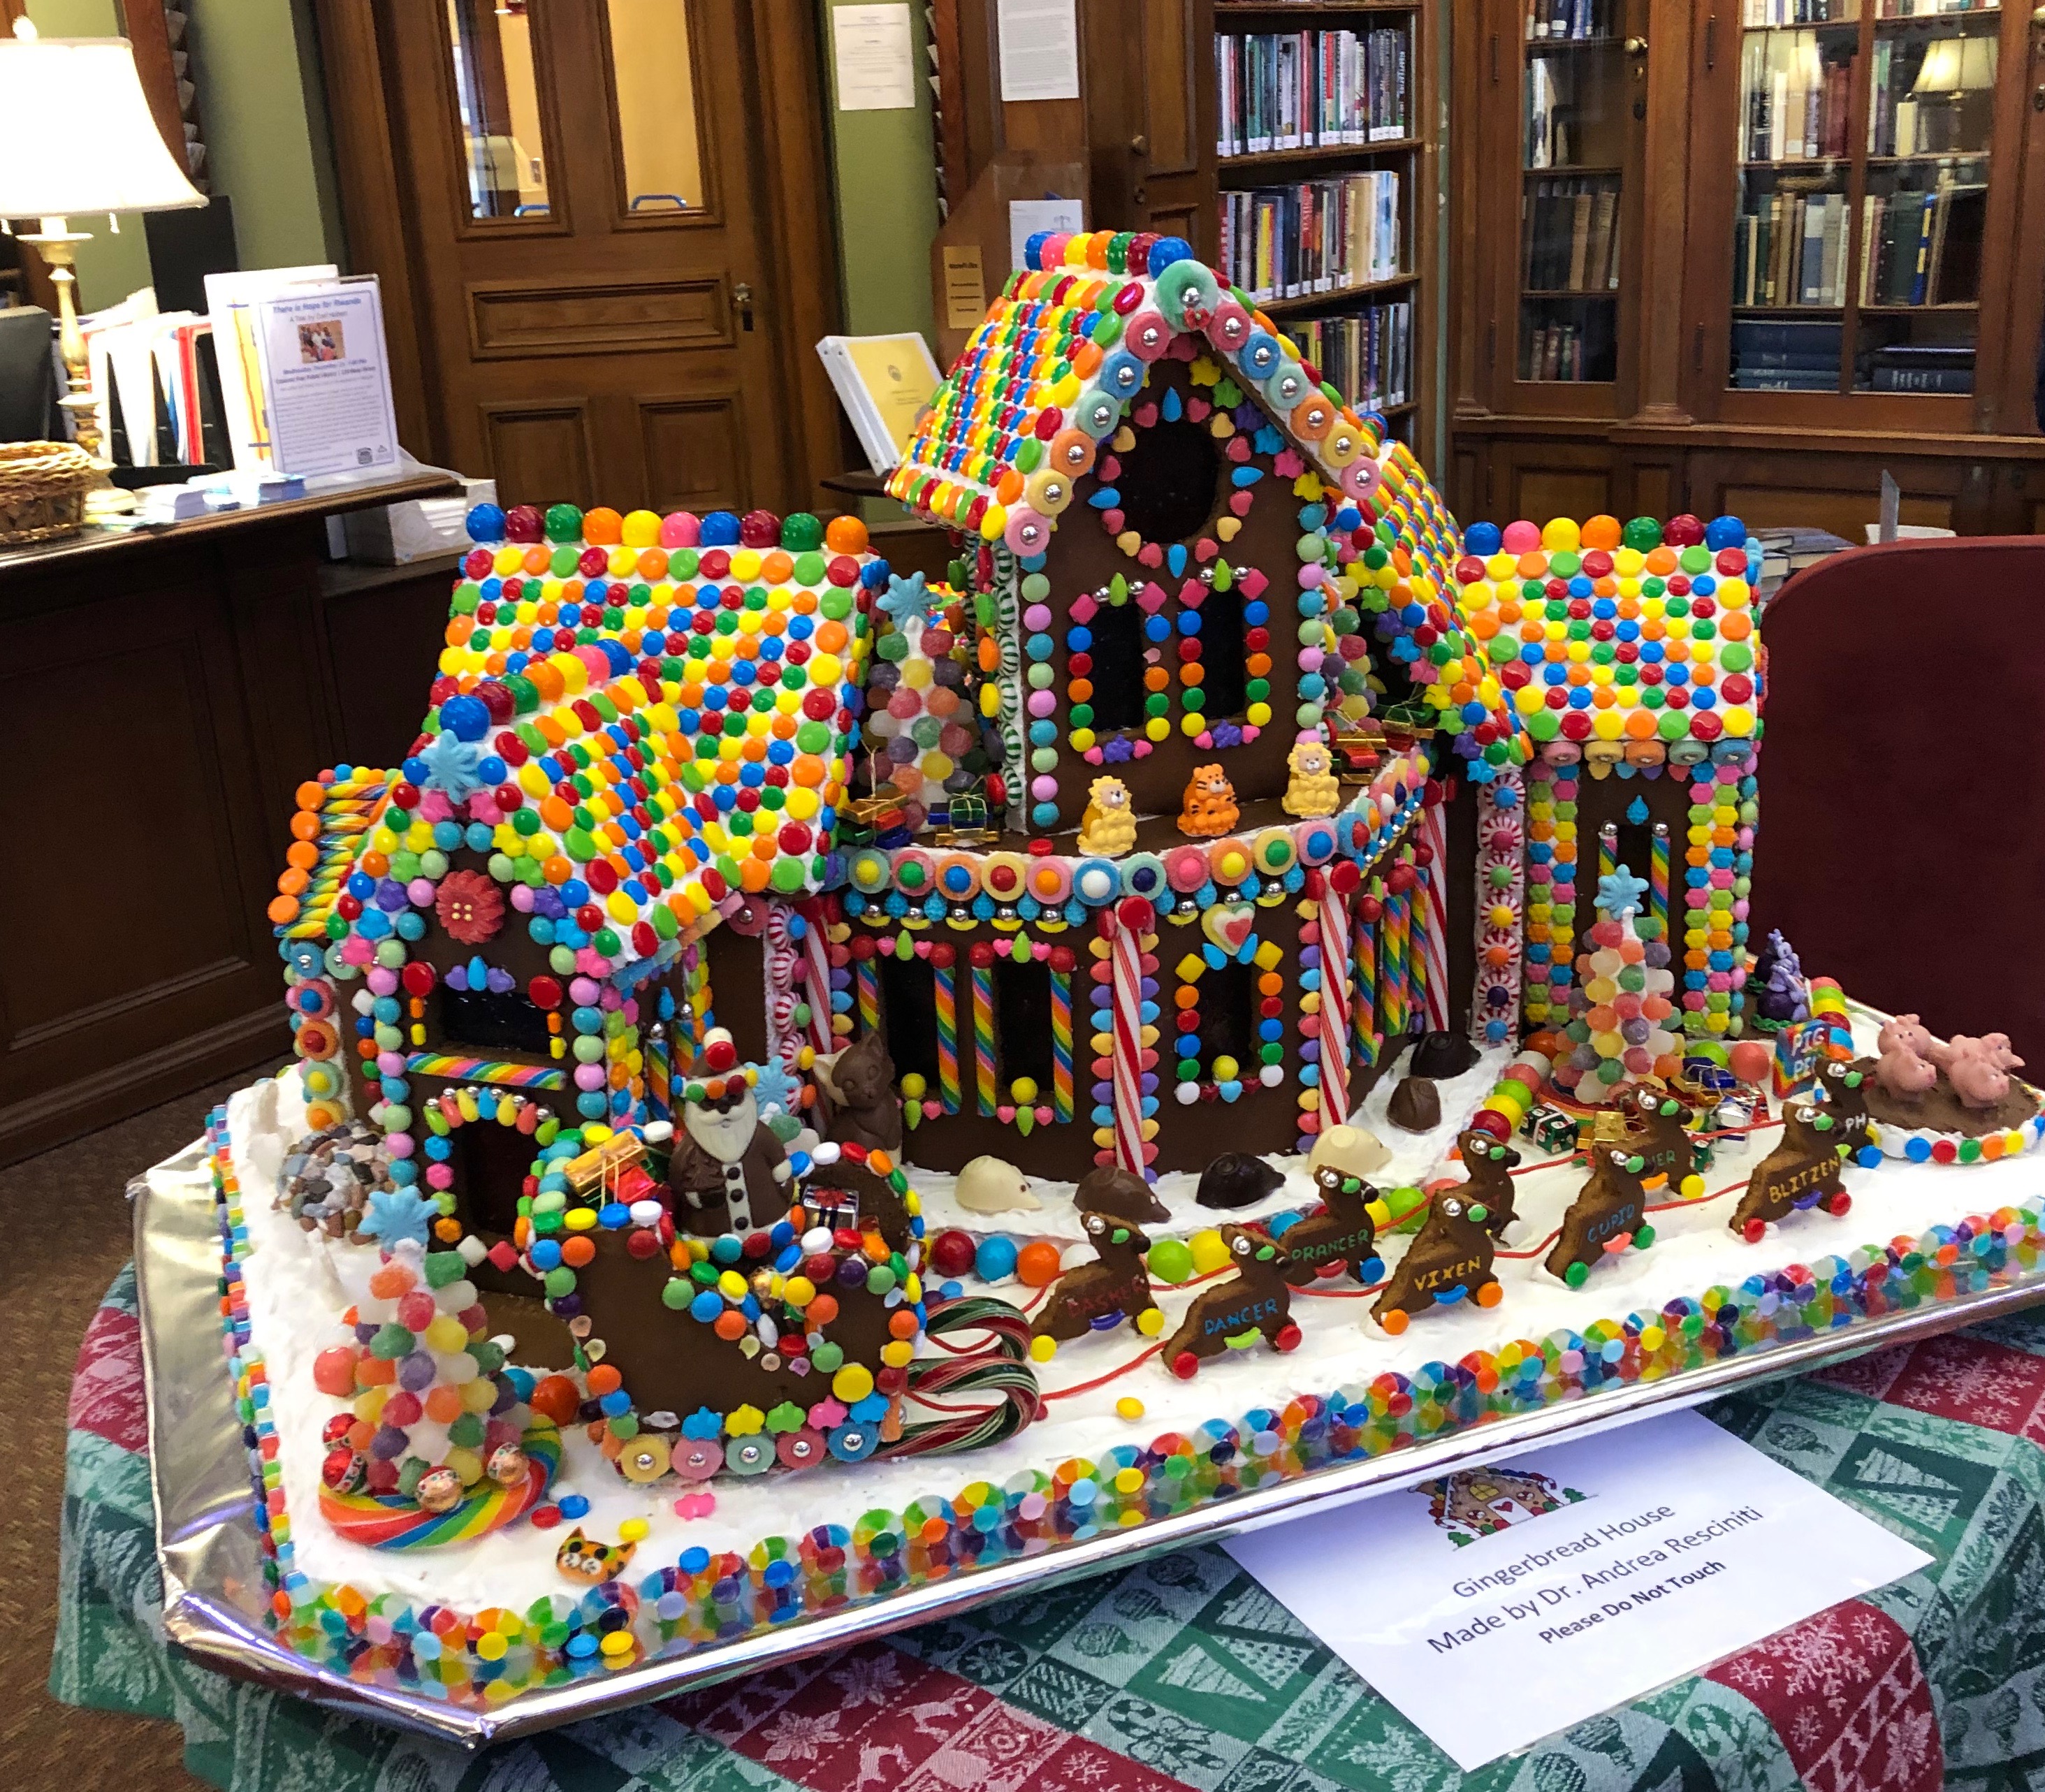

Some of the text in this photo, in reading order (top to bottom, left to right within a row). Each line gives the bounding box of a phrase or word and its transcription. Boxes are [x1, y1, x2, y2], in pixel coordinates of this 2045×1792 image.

[1791, 1027, 1826, 1057] PIG
[1768, 1156, 1840, 1204] BLITZEN
[1587, 1204, 1635, 1243] CUPID
[1292, 1228, 1369, 1262] PRANCER
[1413, 1255, 1481, 1292] VIXEN
[1204, 1297, 1279, 1335] DANCER
[1453, 1506, 1675, 1597] Gingerbread House
[1427, 1506, 1764, 1654] Made by Dr. Andrea Resciniti
[1538, 1560, 1727, 1644] Please Do Not Touch
